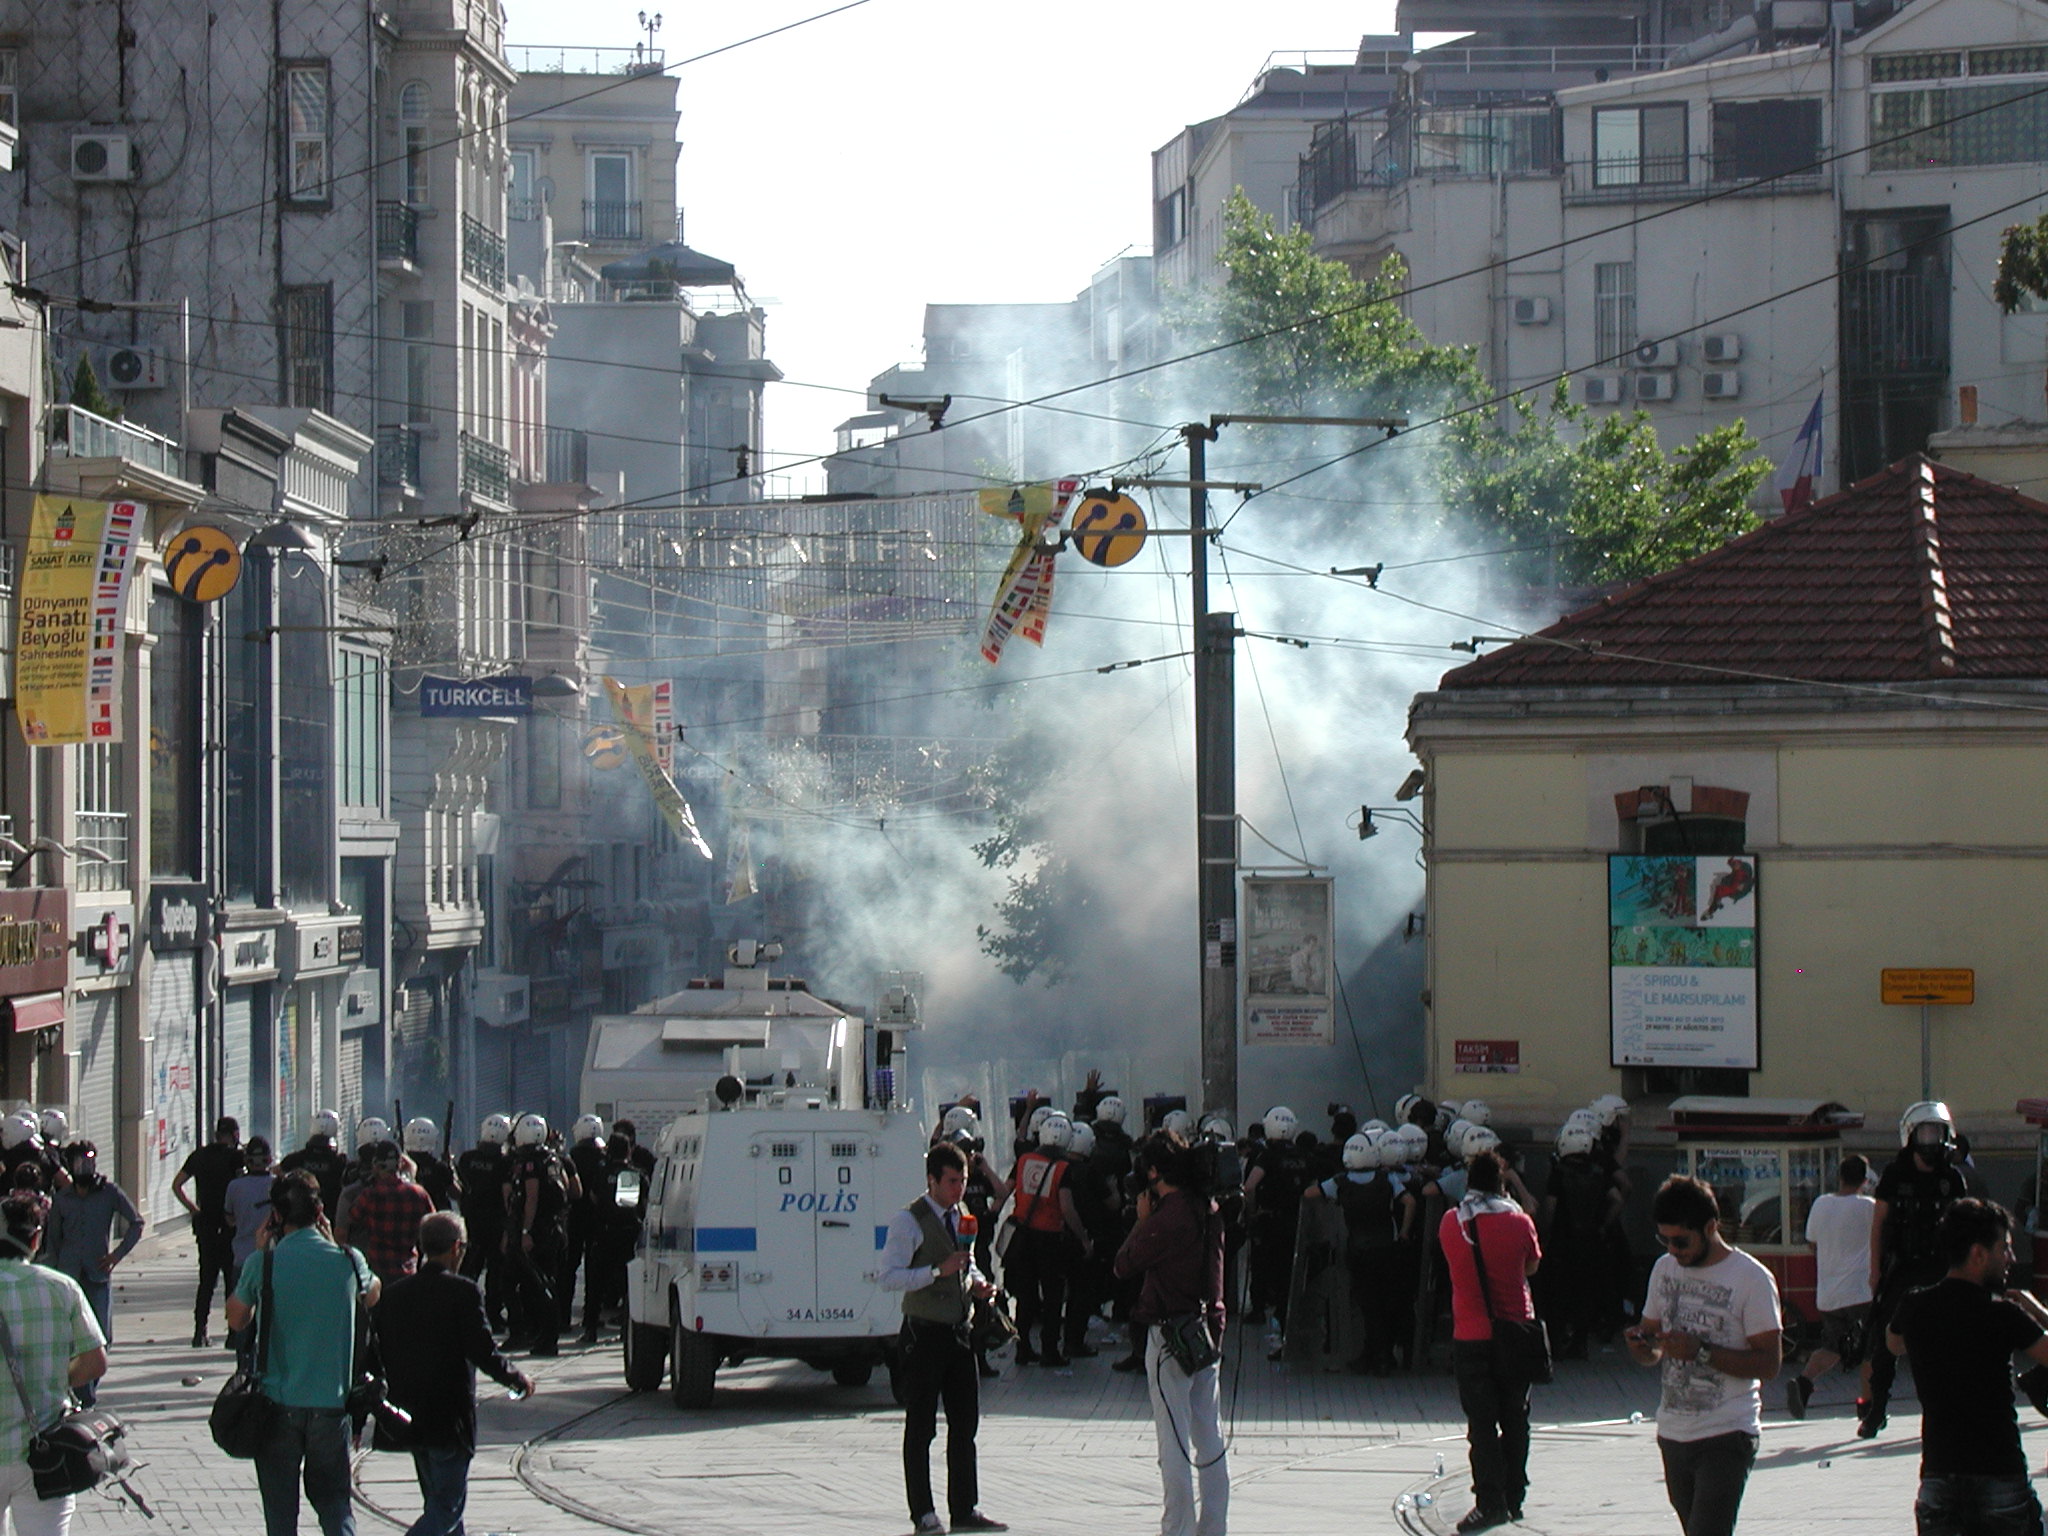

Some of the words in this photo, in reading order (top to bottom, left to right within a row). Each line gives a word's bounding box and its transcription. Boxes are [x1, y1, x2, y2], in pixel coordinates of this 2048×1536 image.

[31, 555, 64, 565] SANAT
[69, 554, 93, 564] ART
[24, 597, 88, 612] Dünyanın
[24, 609, 87, 629] Sanatı
[22, 628, 86, 649] Beyoğlu
[20, 648, 85, 661] Sahnesinde
[427, 686, 526, 706] TURKCELL
[1644, 975, 1688, 987] SPIROU
[1690, 975, 1699, 987] &
[1644, 993, 1659, 1005] LE
[1662, 993, 1747, 1006] MARSUPILAMI
[780, 1188, 859, 1212] POLİS
[787, 1309, 801, 1320] 34
